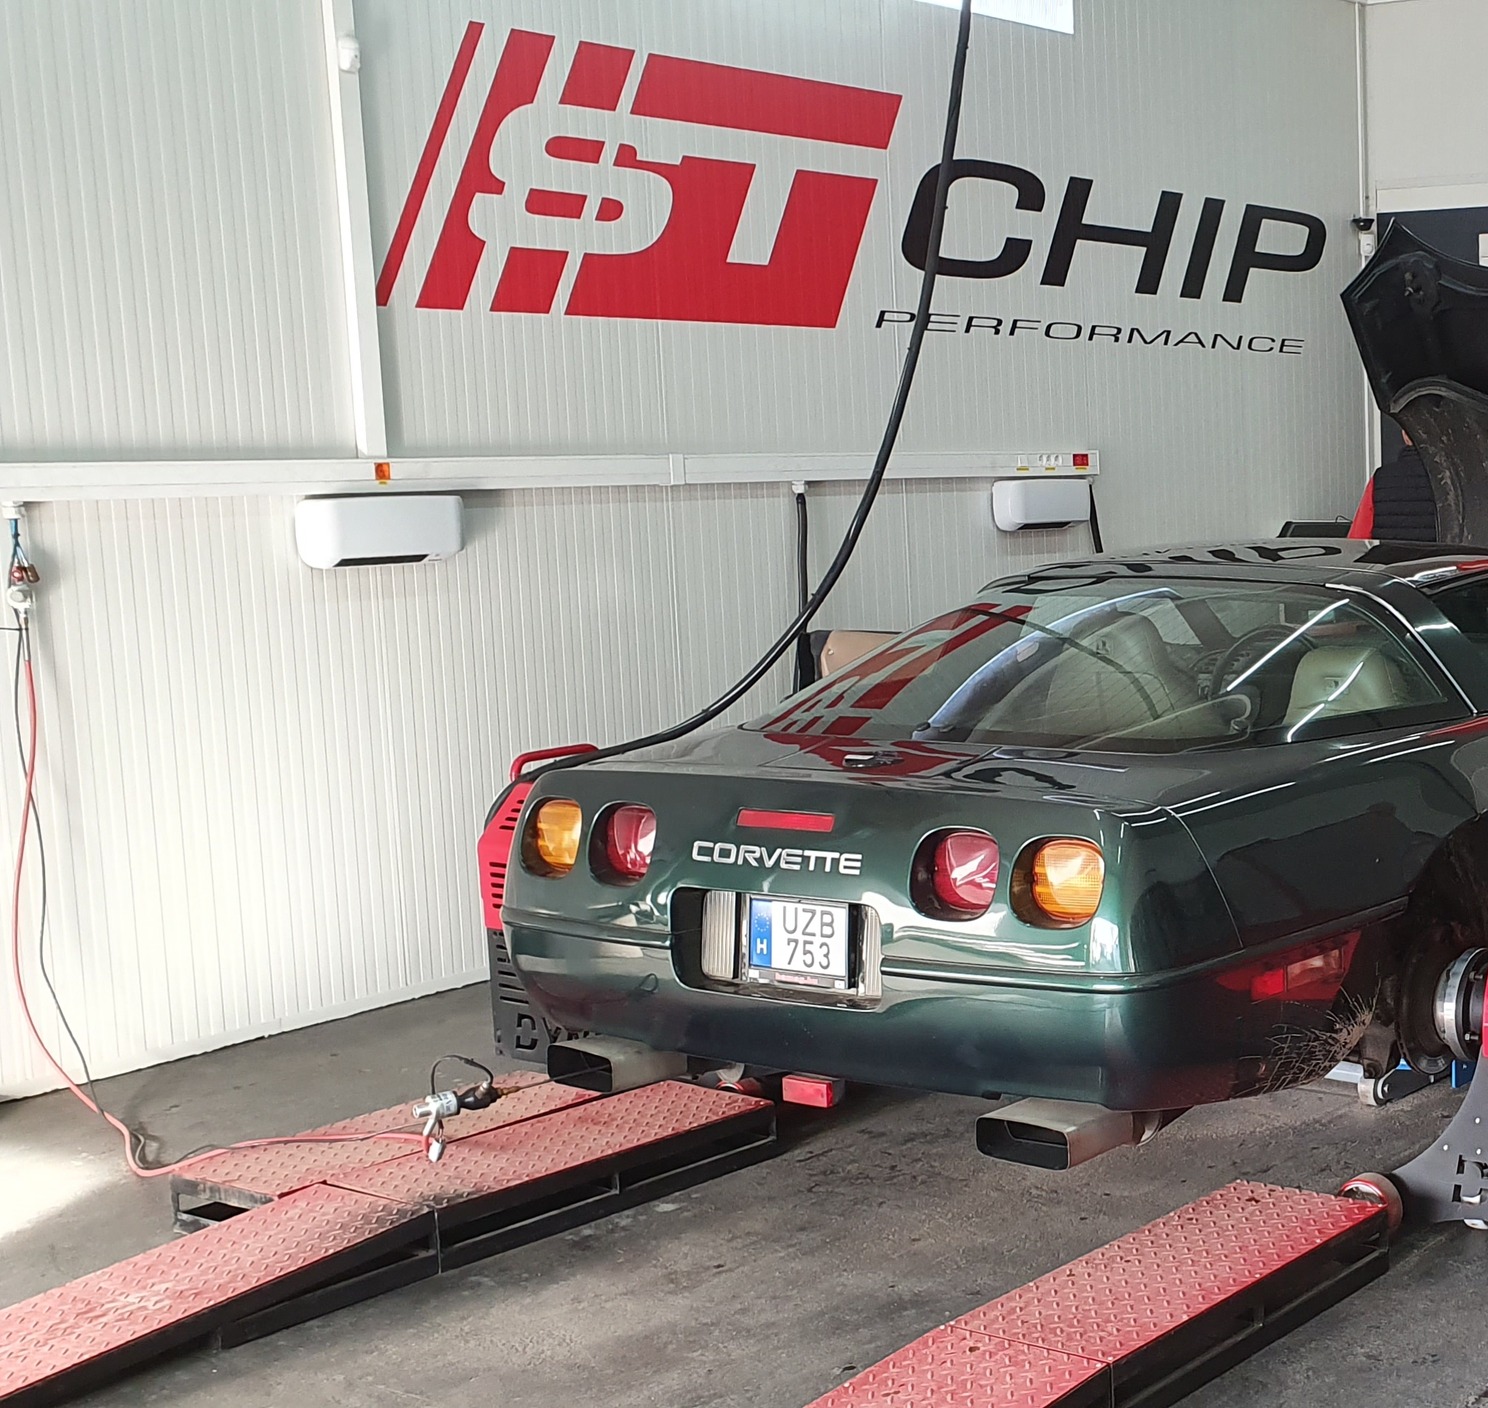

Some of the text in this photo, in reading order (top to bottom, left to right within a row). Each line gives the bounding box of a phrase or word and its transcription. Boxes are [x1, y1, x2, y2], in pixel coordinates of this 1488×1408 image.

[467, 103, 1327, 303] ST CHIP
[874, 310, 1306, 355] PERFORMANCE
[691, 840, 863, 876] CORVETTE
[782, 905, 835, 939] UZB
[756, 937, 768, 955] H
[786, 938, 831, 970] 753
